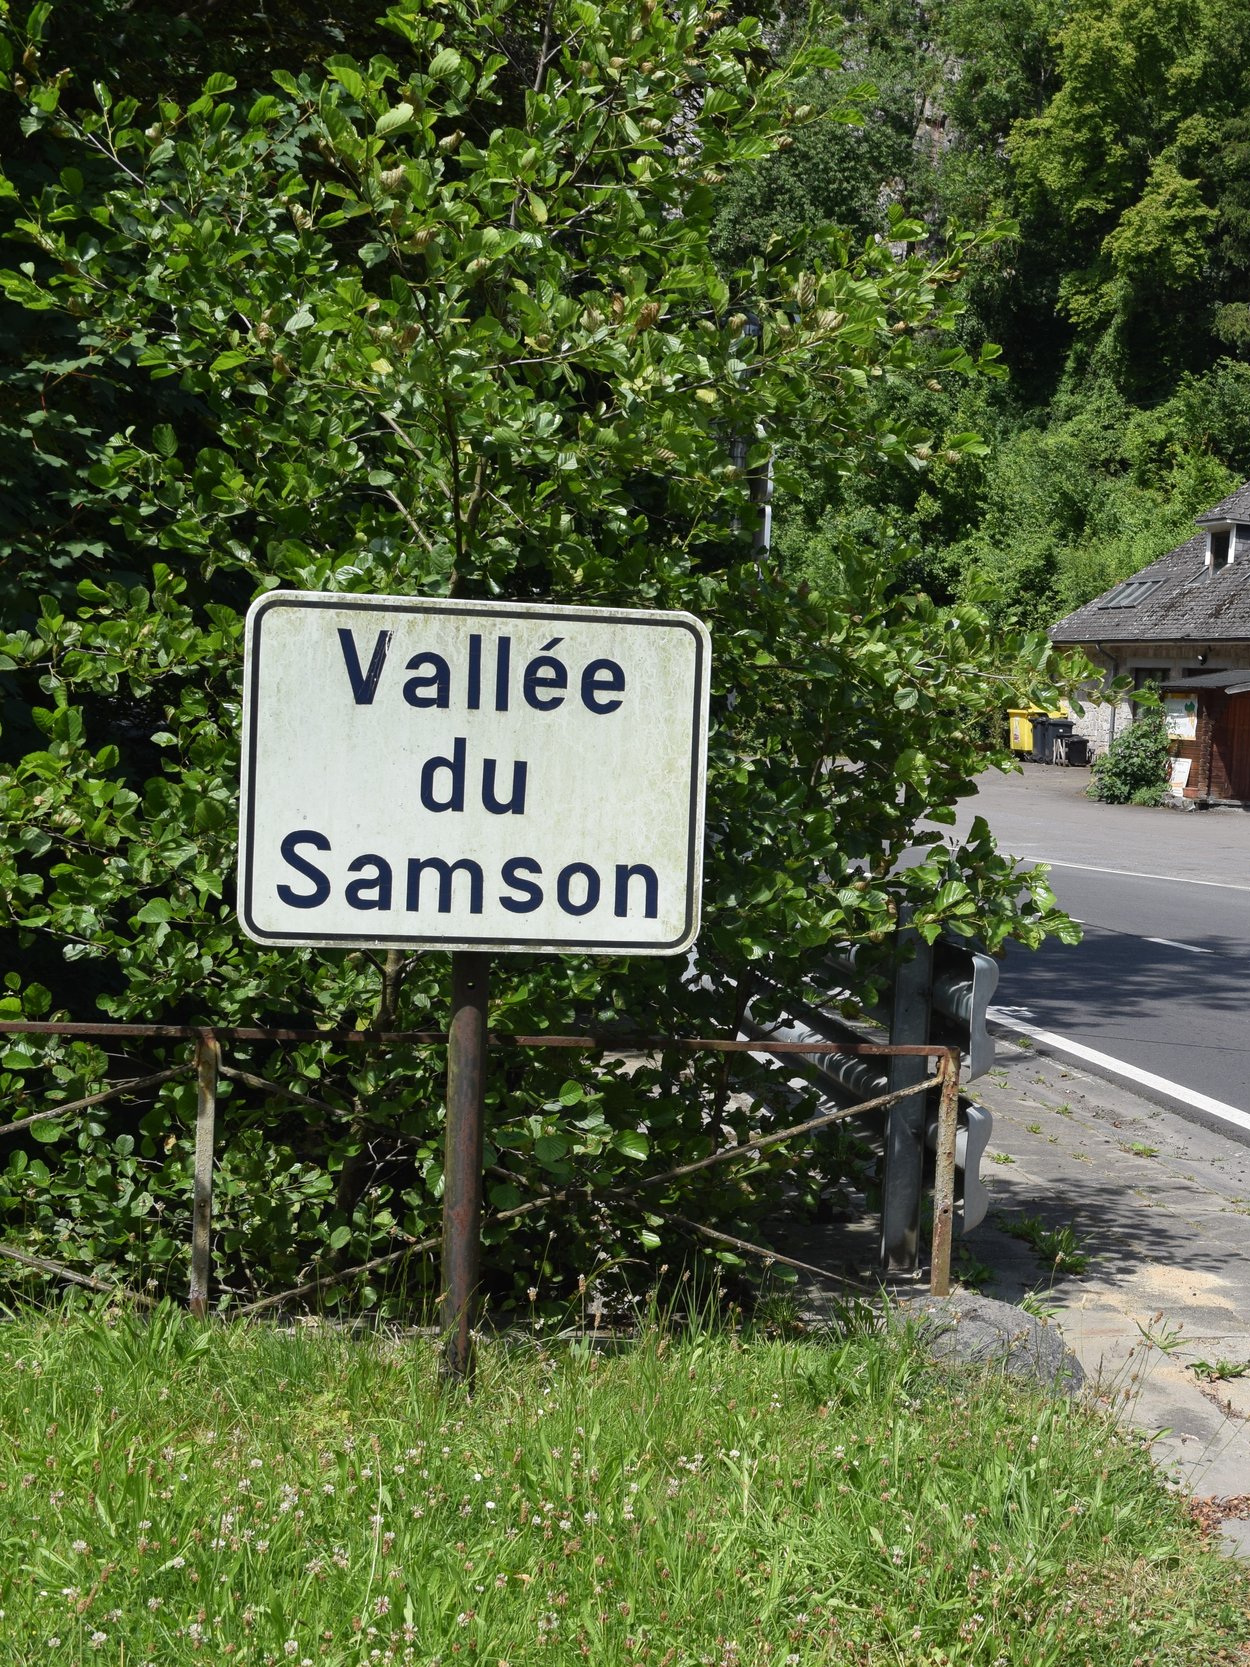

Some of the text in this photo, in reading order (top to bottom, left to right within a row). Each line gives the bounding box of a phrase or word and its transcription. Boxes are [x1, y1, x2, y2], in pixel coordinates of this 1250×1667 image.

[337, 628, 626, 715] Vallée
[420, 737, 528, 815] du
[277, 829, 659, 919] Samson
